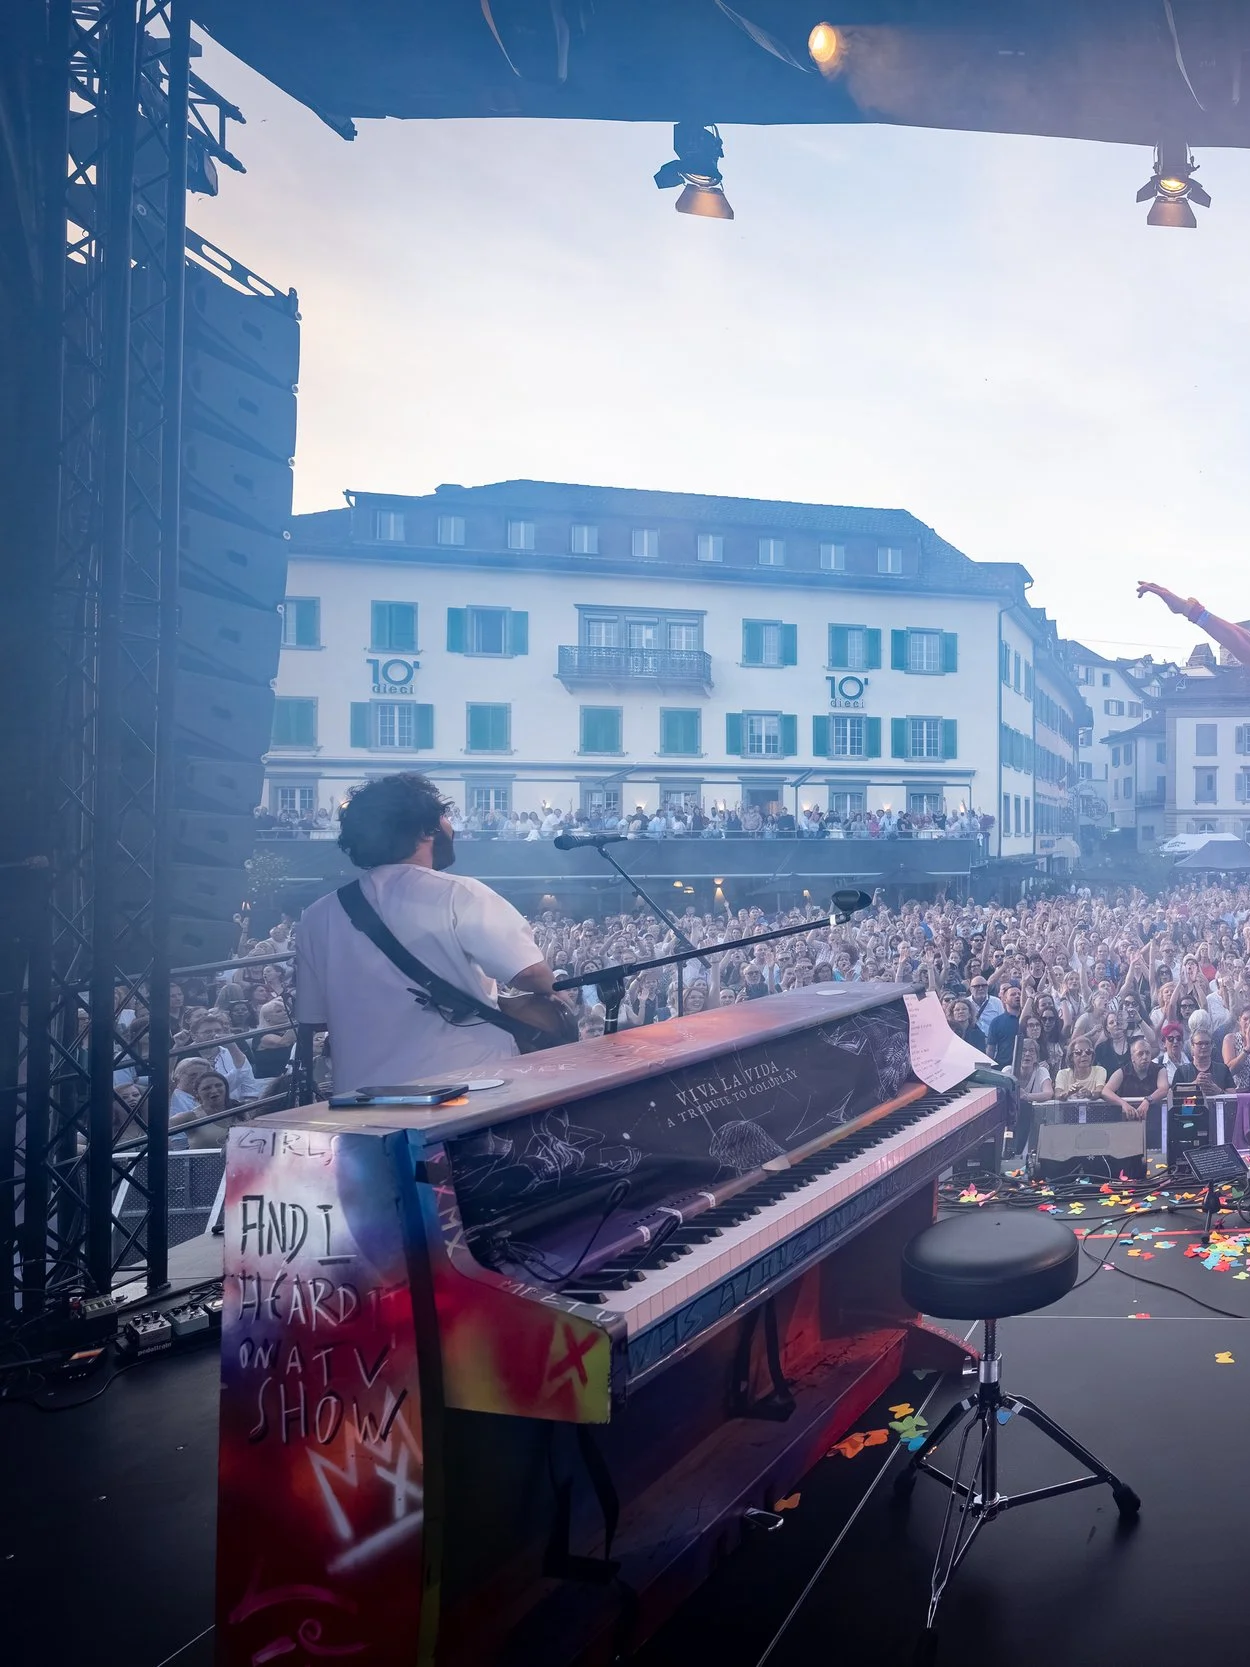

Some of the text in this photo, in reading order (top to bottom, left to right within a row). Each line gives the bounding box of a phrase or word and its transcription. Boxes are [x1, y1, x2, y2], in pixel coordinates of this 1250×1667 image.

[372, 684, 414, 695] dieci
[830, 699, 864, 709] dieci
[665, 1069, 799, 1129] A TRIBUTE TO COLDPLAY
[676, 1060, 780, 1106] VIVA LA VIDA
[239, 1194, 357, 1266] AND I
[238, 1270, 361, 1332] HEARD
[239, 1337, 281, 1370] ON
[286, 1345, 303, 1376] A
[249, 1376, 409, 1444] SHOW
